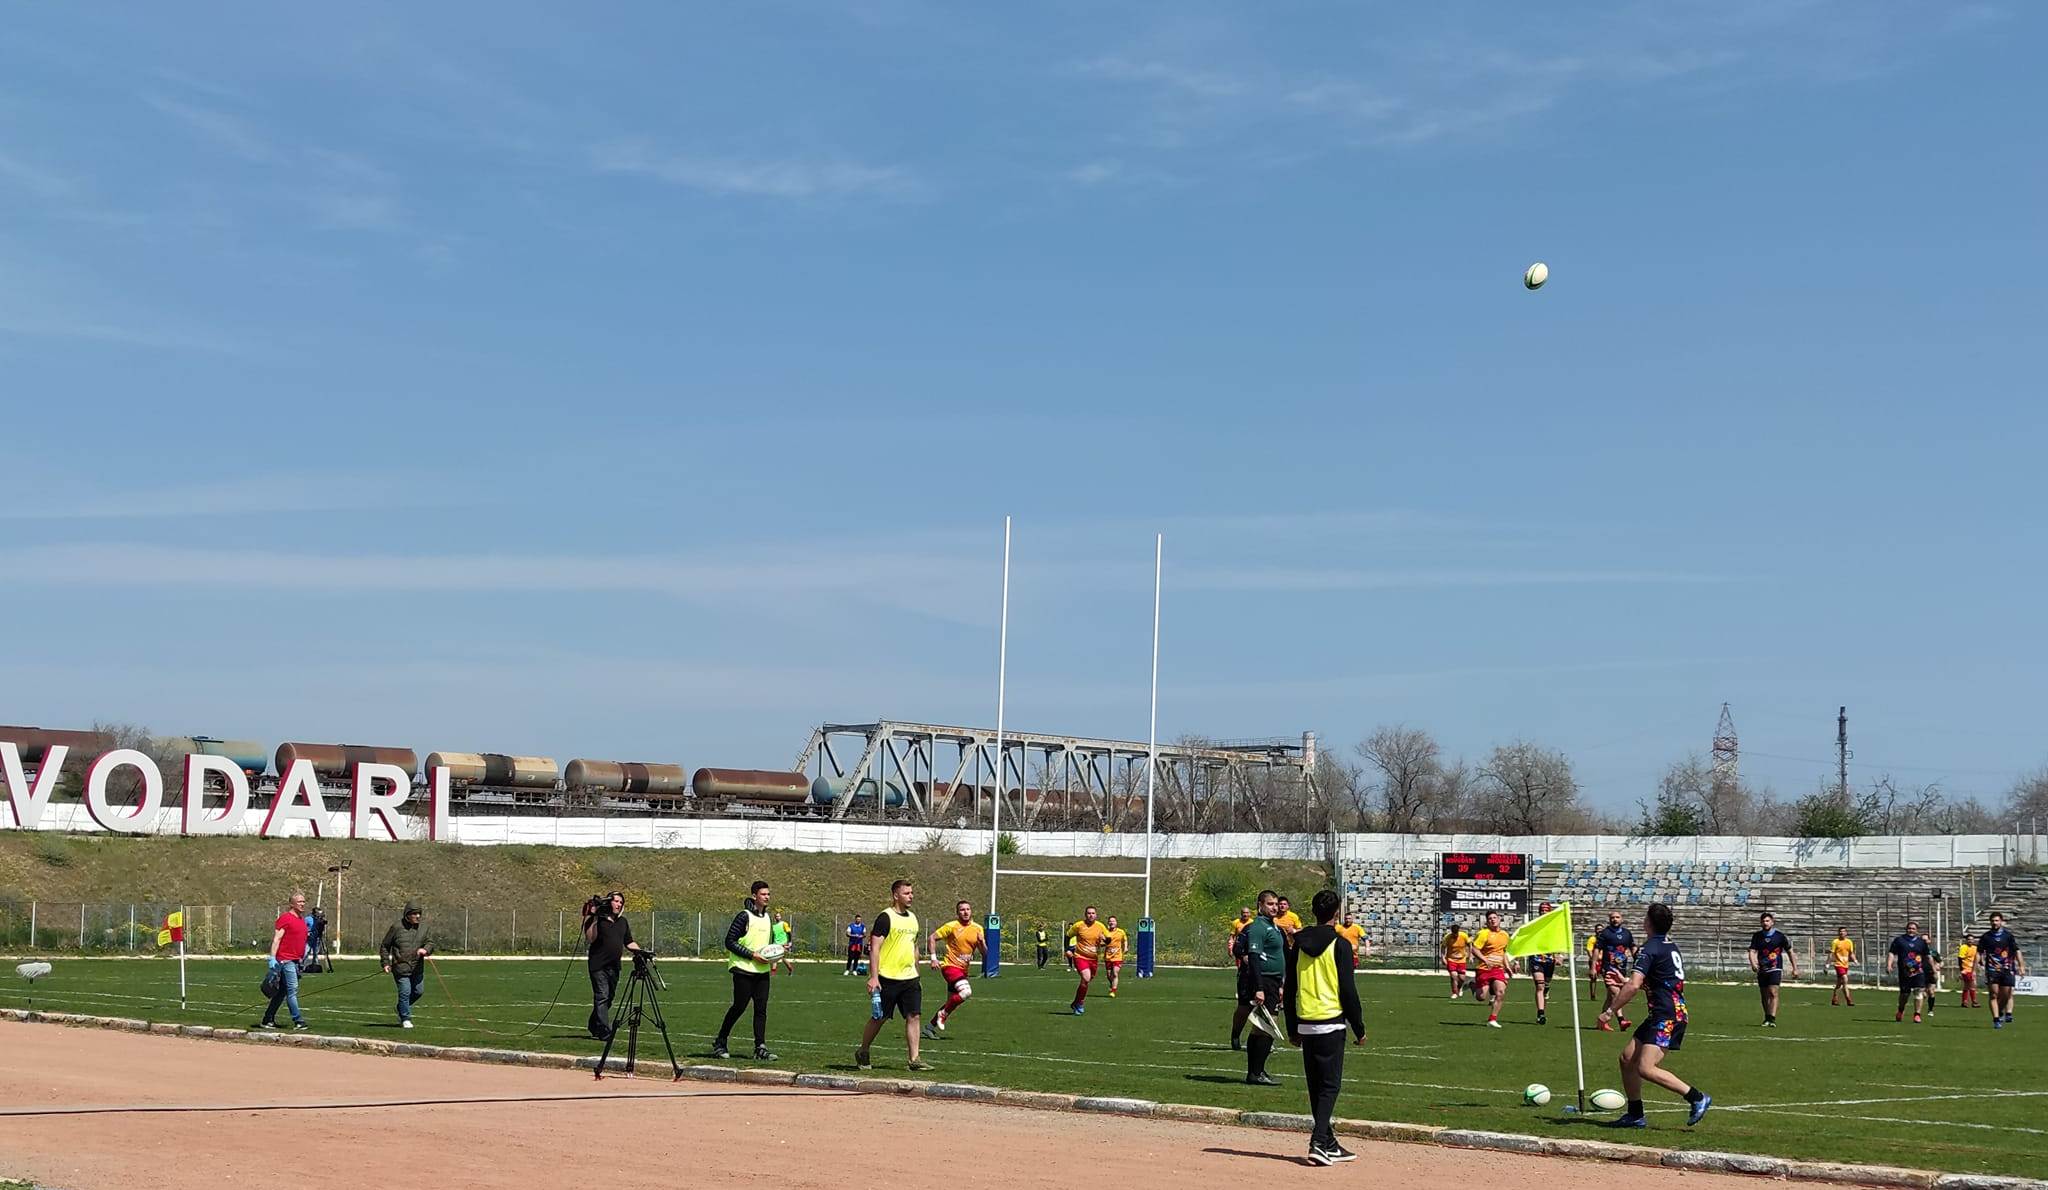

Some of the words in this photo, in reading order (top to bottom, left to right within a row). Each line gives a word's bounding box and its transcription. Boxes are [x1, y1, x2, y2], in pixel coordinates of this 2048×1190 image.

[0, 741, 450, 841] VODARI
[1458, 864, 1469, 872] 39
[1499, 865, 1510, 873] 32
[1456, 891, 1511, 900] SEGURO
[1451, 901, 1517, 910] SECURITY
[1671, 951, 1685, 980] 9
